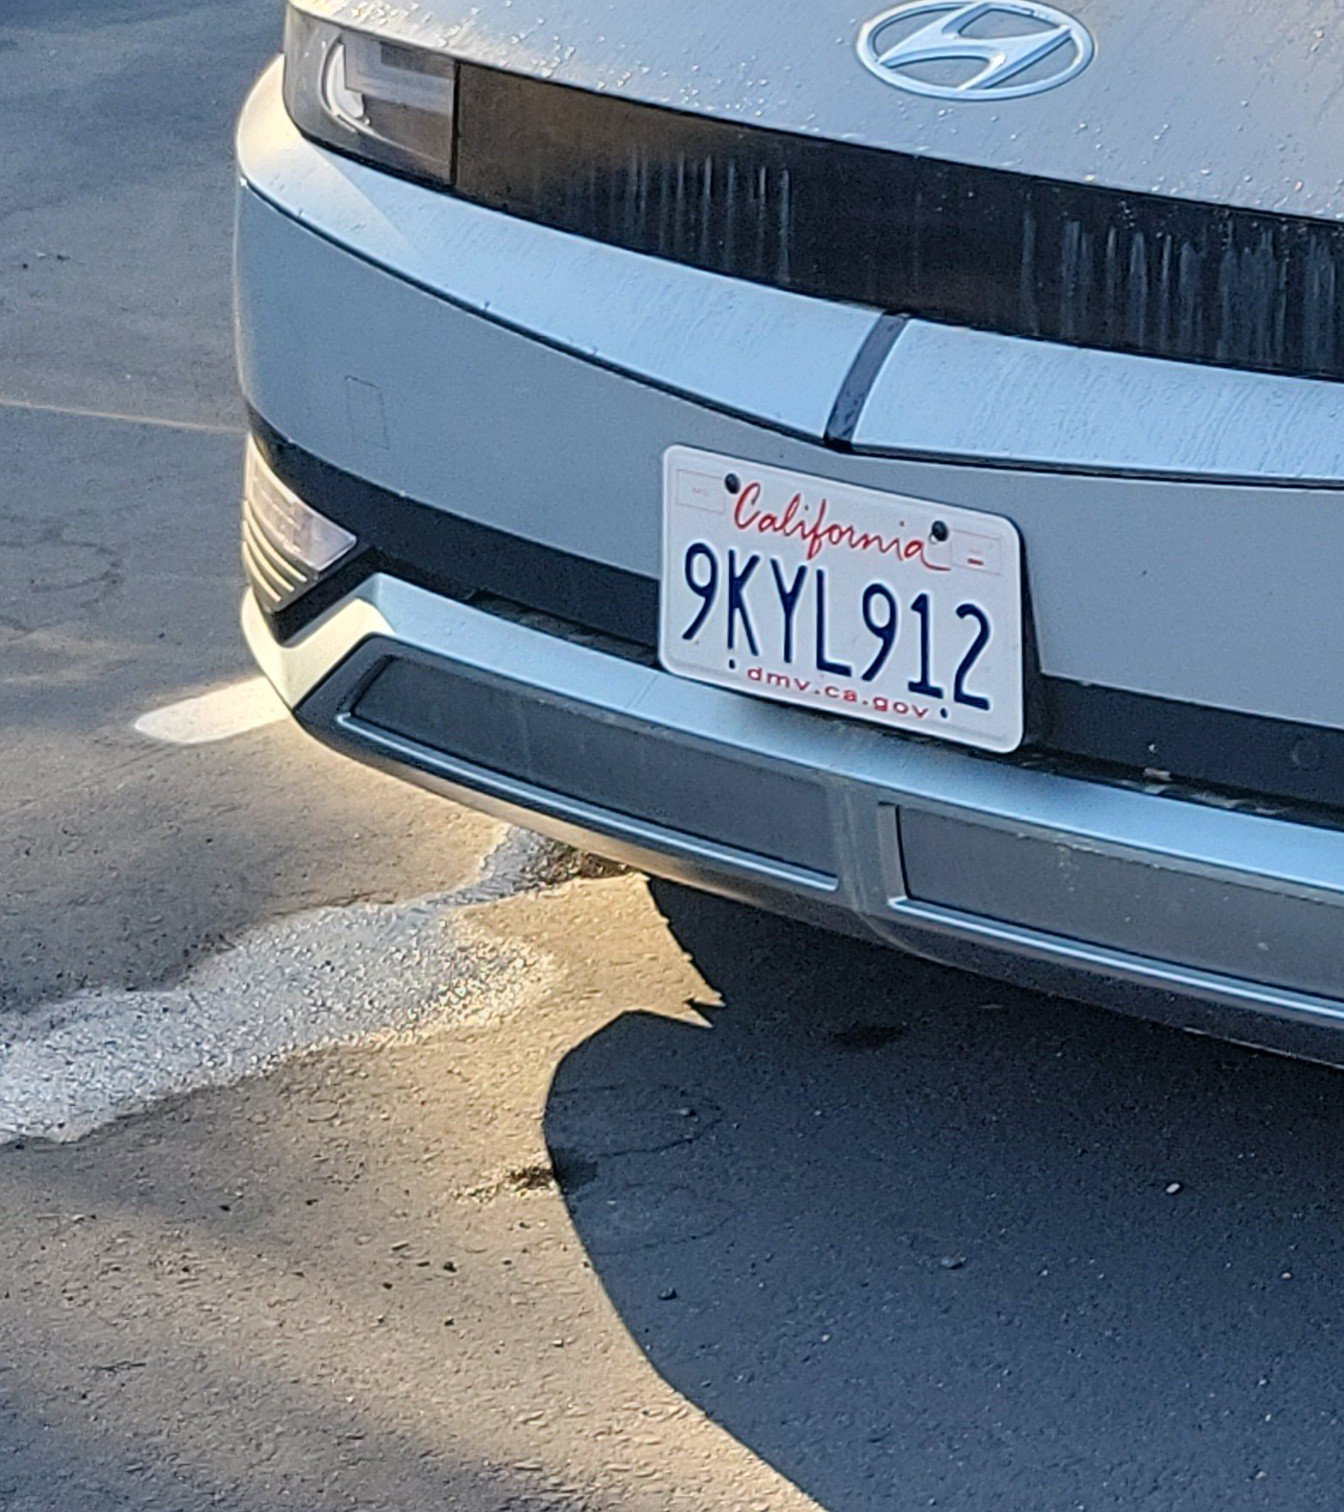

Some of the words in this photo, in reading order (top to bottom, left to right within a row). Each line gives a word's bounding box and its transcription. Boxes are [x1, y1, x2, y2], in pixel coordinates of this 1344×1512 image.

[733, 481, 952, 572] California
[681, 541, 992, 712] 9KYL912
[746, 665, 929, 719] dmv.ca.gov
